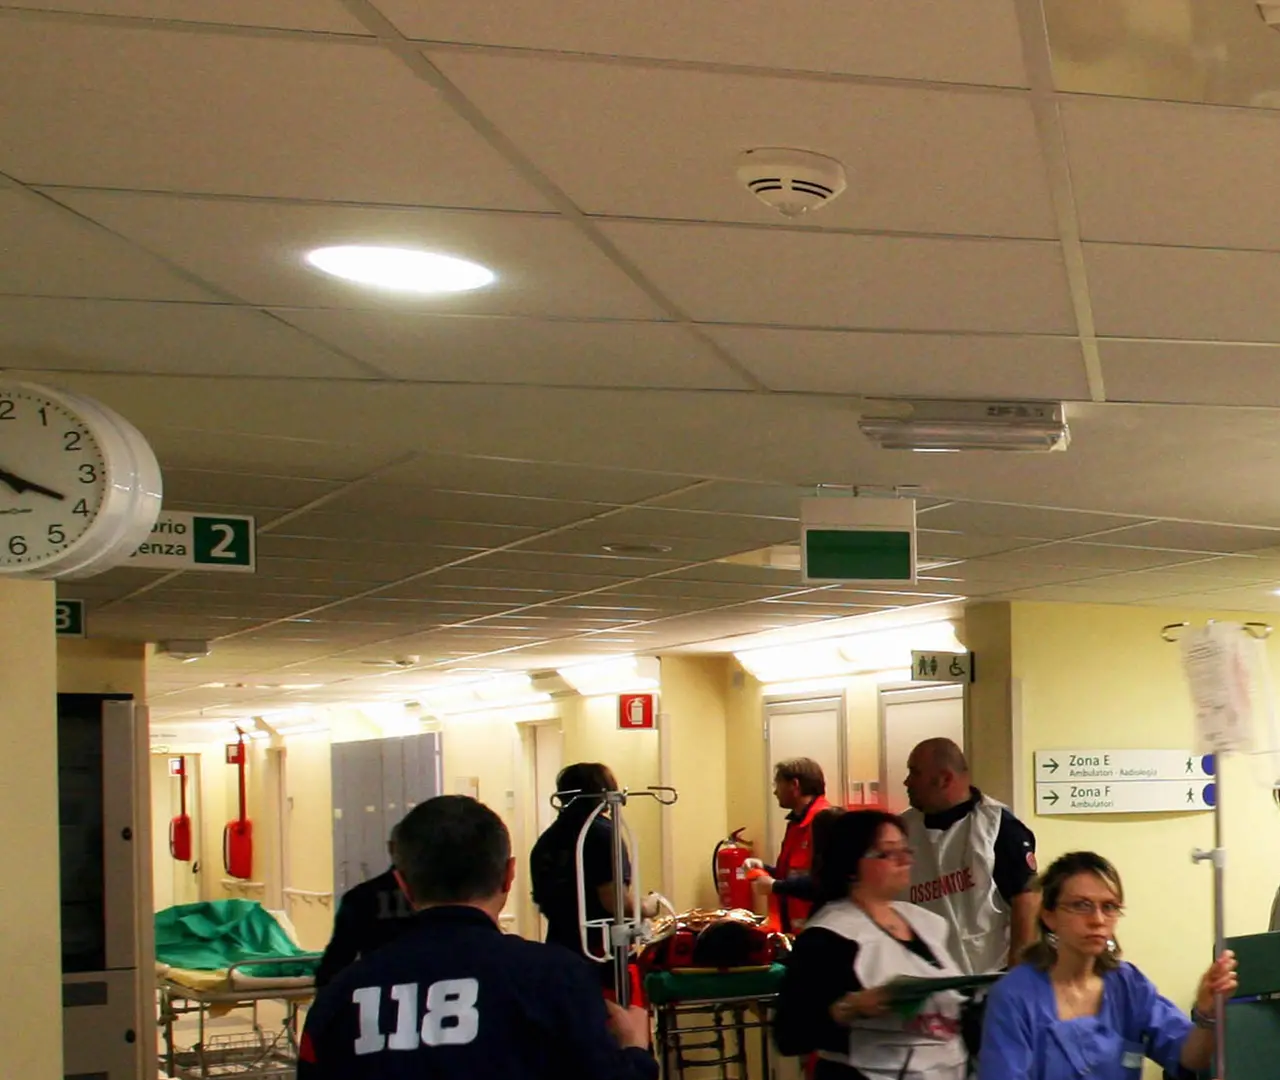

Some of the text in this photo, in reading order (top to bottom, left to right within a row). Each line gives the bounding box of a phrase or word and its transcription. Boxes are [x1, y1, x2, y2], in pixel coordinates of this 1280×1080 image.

[38, 407, 47, 426] 1
[63, 431, 81, 451] 2
[78, 464, 97, 483] 3
[72, 499, 89, 517] 4
[47, 524, 66, 543] 5
[210, 523, 237, 559] 2
[8, 536, 27, 555] 6
[1069, 754, 1111, 767] Zona E
[1069, 769, 1113, 778] Ambulatori
[1070, 786, 1111, 798] Zona F
[1070, 800, 1114, 809] Ambulatori
[352, 978, 480, 1056] 118
